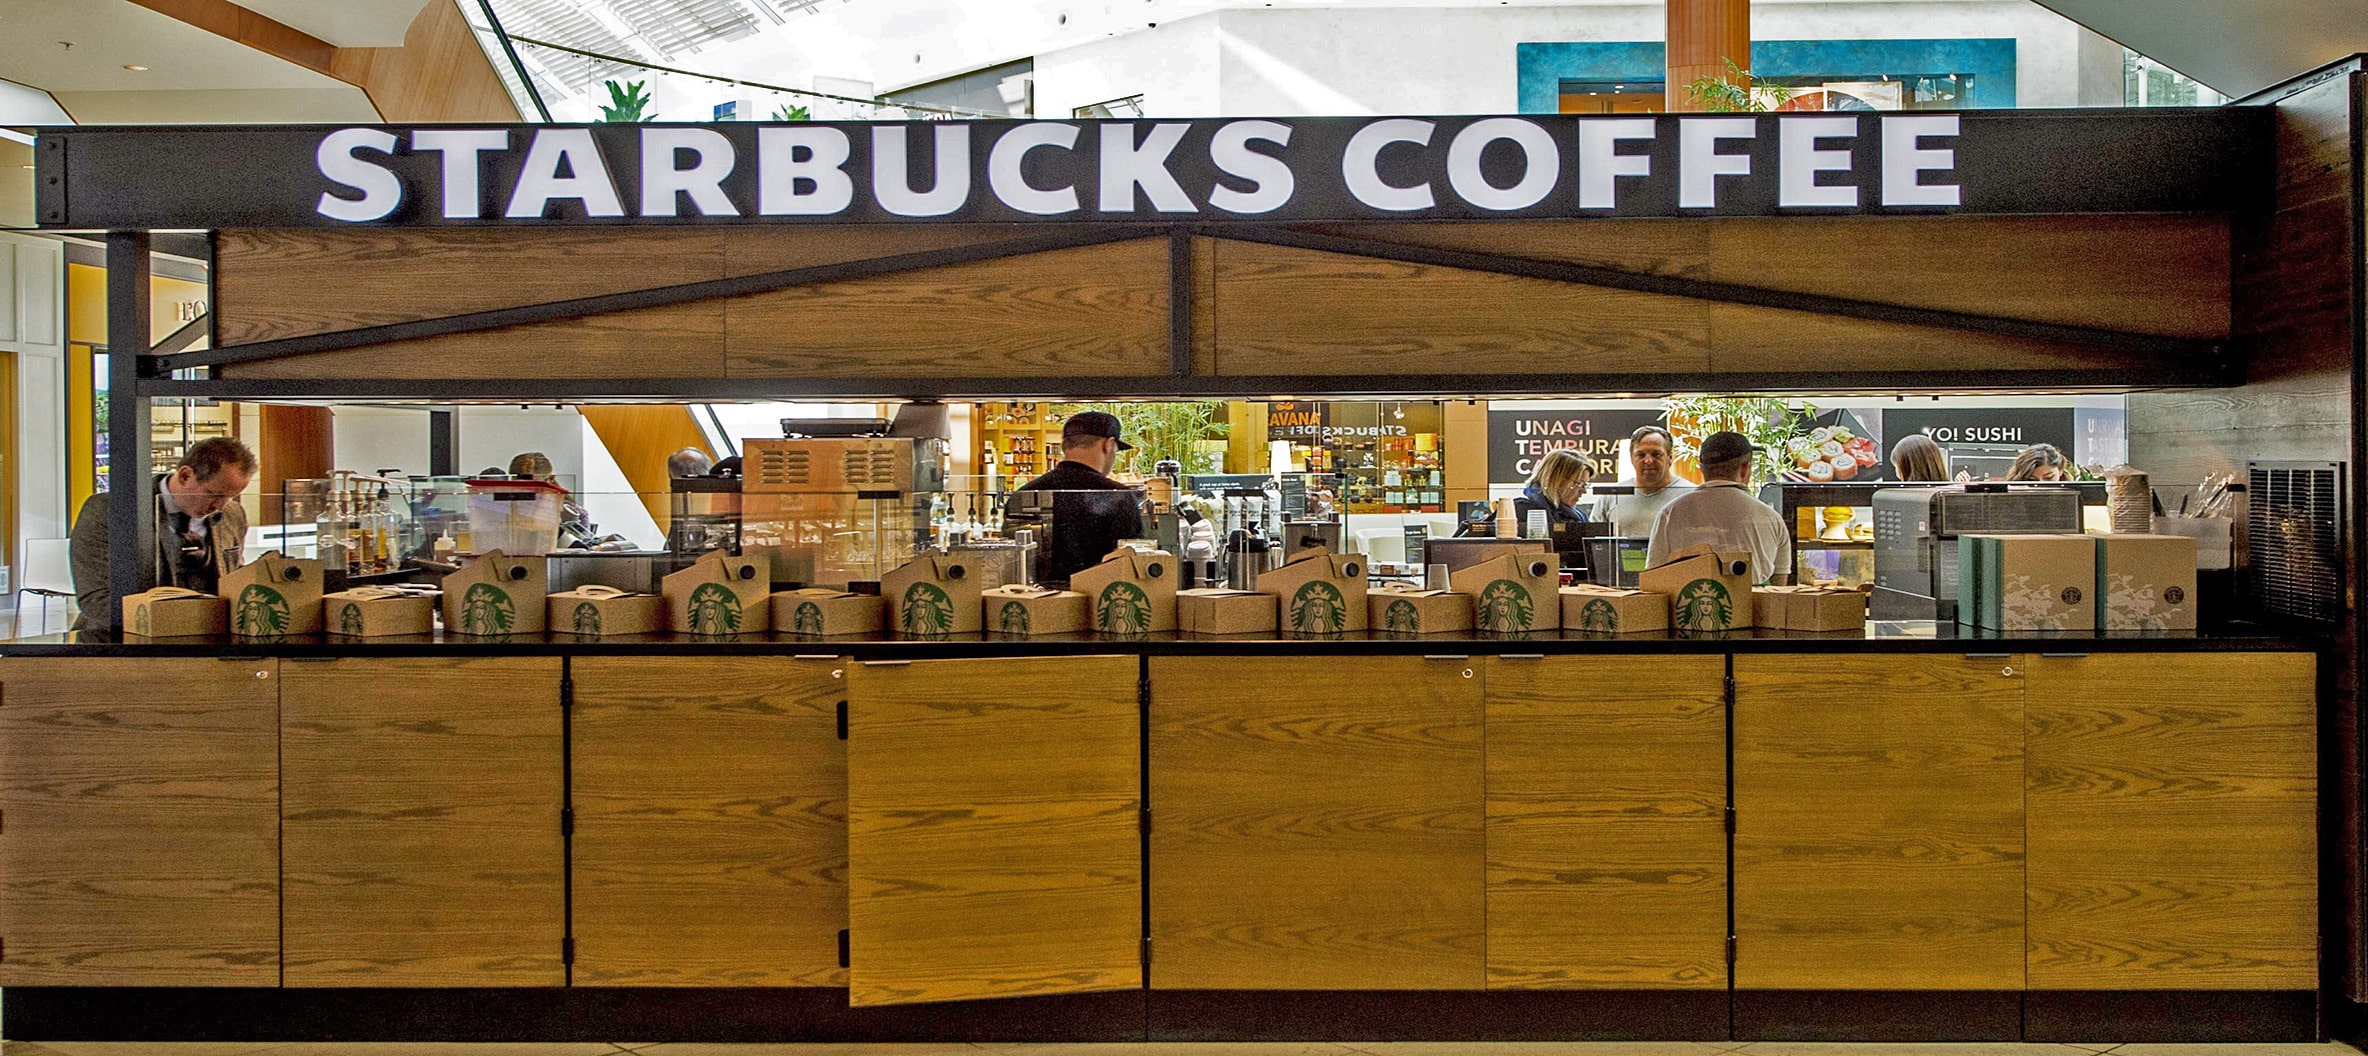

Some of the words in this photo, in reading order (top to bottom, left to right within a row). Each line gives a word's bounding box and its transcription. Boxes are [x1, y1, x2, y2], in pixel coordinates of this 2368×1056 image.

[316, 120, 1294, 222] STARBUCKS
[1342, 116, 1961, 211] COFFEE
[1515, 419, 1592, 436] UNAGI
[1922, 427, 1958, 441] YO!
[1964, 427, 2022, 441] SUSHI
[1514, 439, 1620, 456] TEMPURA
